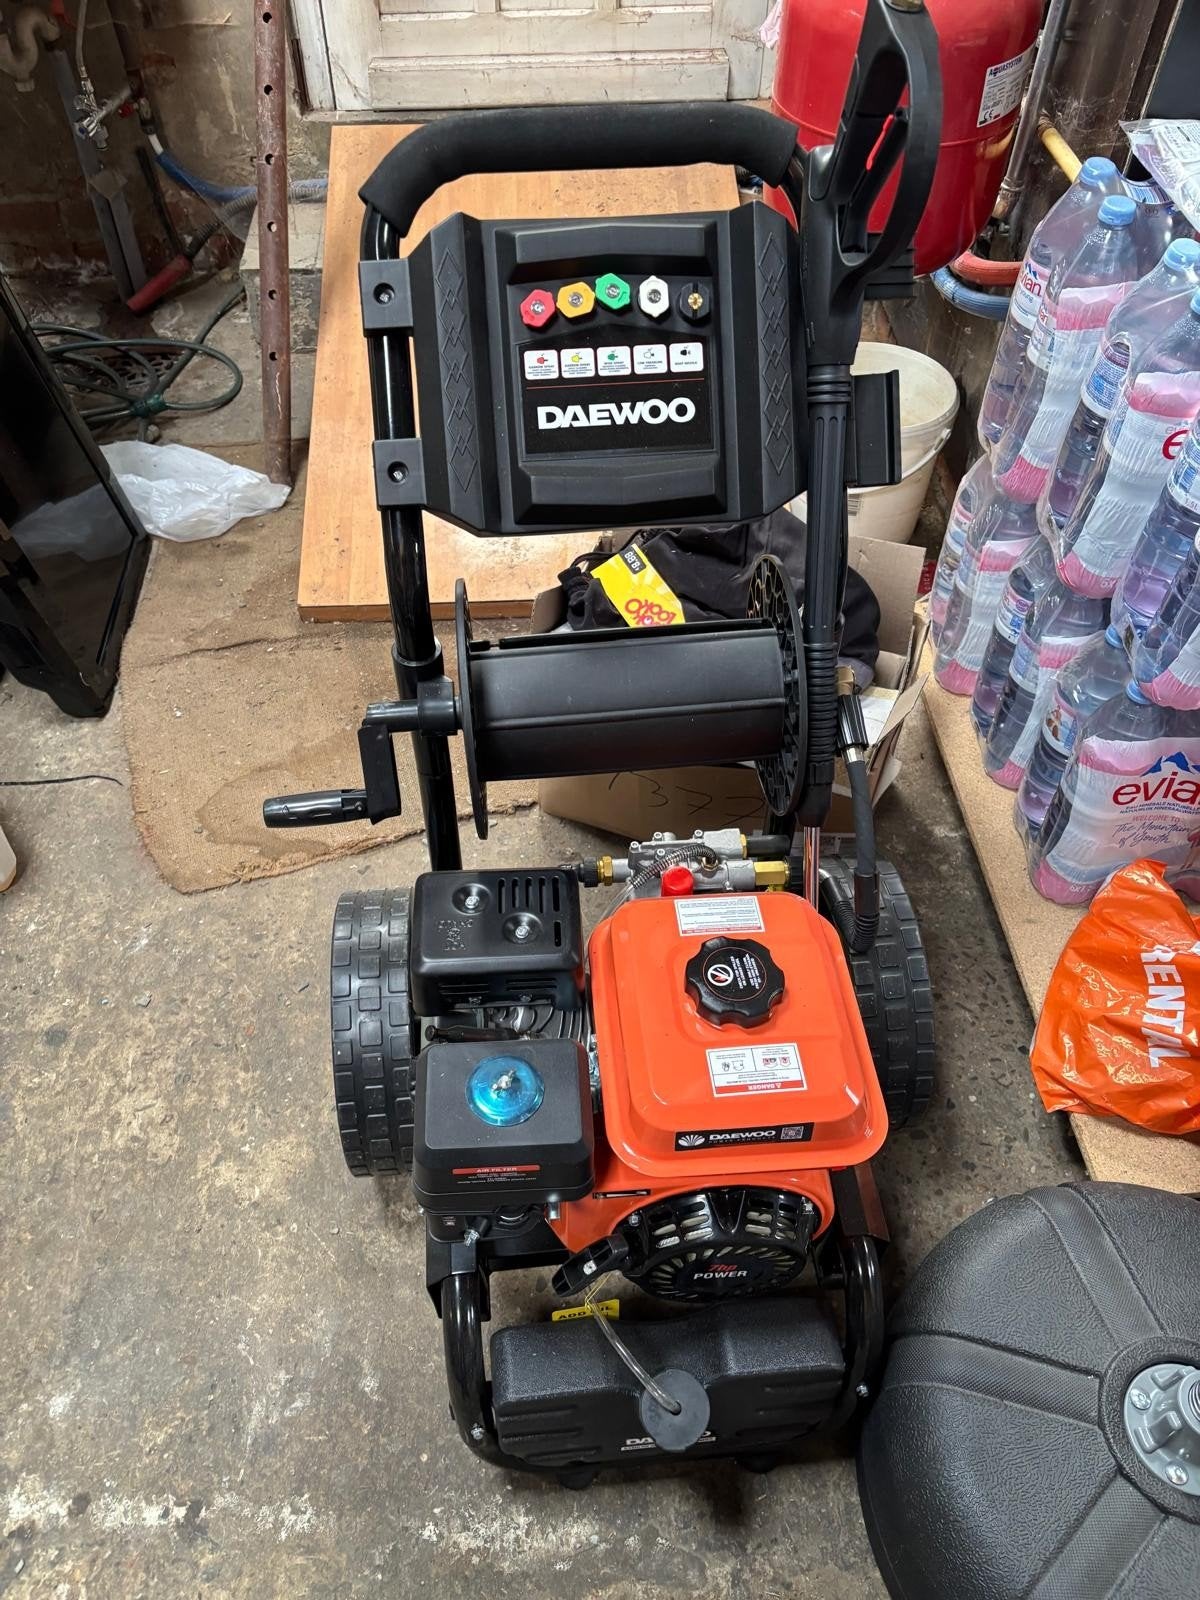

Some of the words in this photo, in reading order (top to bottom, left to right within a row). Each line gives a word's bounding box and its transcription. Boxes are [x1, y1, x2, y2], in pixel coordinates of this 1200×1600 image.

[537, 397, 696, 430] DAEWOO
[1112, 771, 1200, 806] evia
[1140, 944, 1191, 1068] RENTAL
[748, 1083, 775, 1091] DANGER
[709, 1130, 776, 1141] DAEWOO
[693, 1270, 748, 1280] POWER
